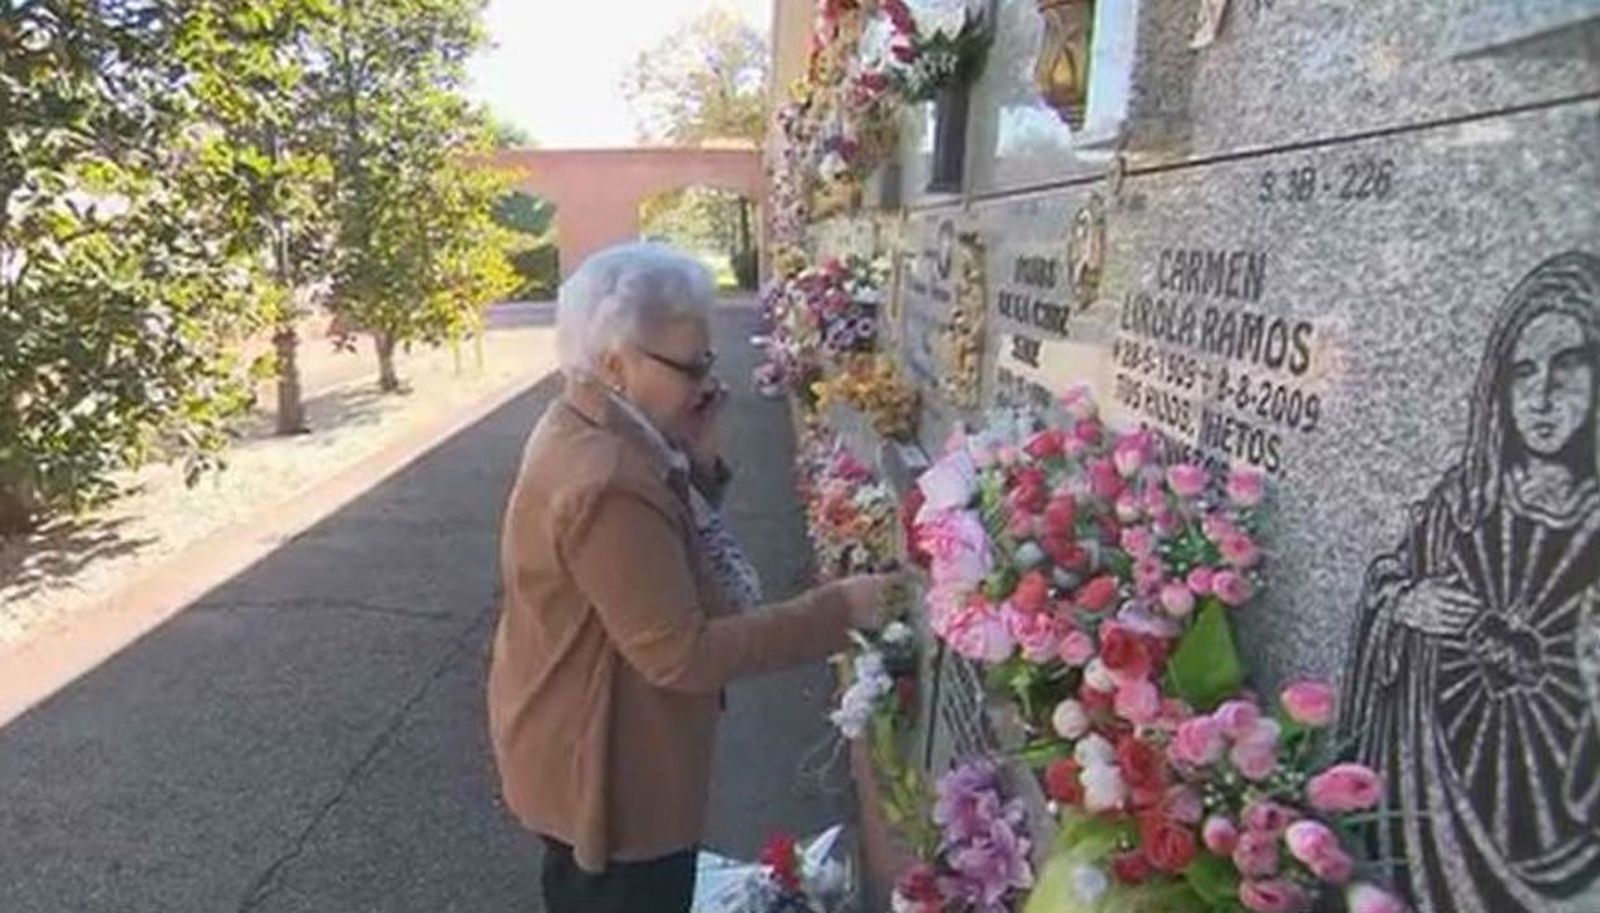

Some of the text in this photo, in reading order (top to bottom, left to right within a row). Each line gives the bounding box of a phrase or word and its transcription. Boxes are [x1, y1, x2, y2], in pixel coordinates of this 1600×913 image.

[1338, 158, 1395, 200] 226
[1157, 248, 1268, 302] CARMEN
[1199, 306, 1314, 377] RAMOS
